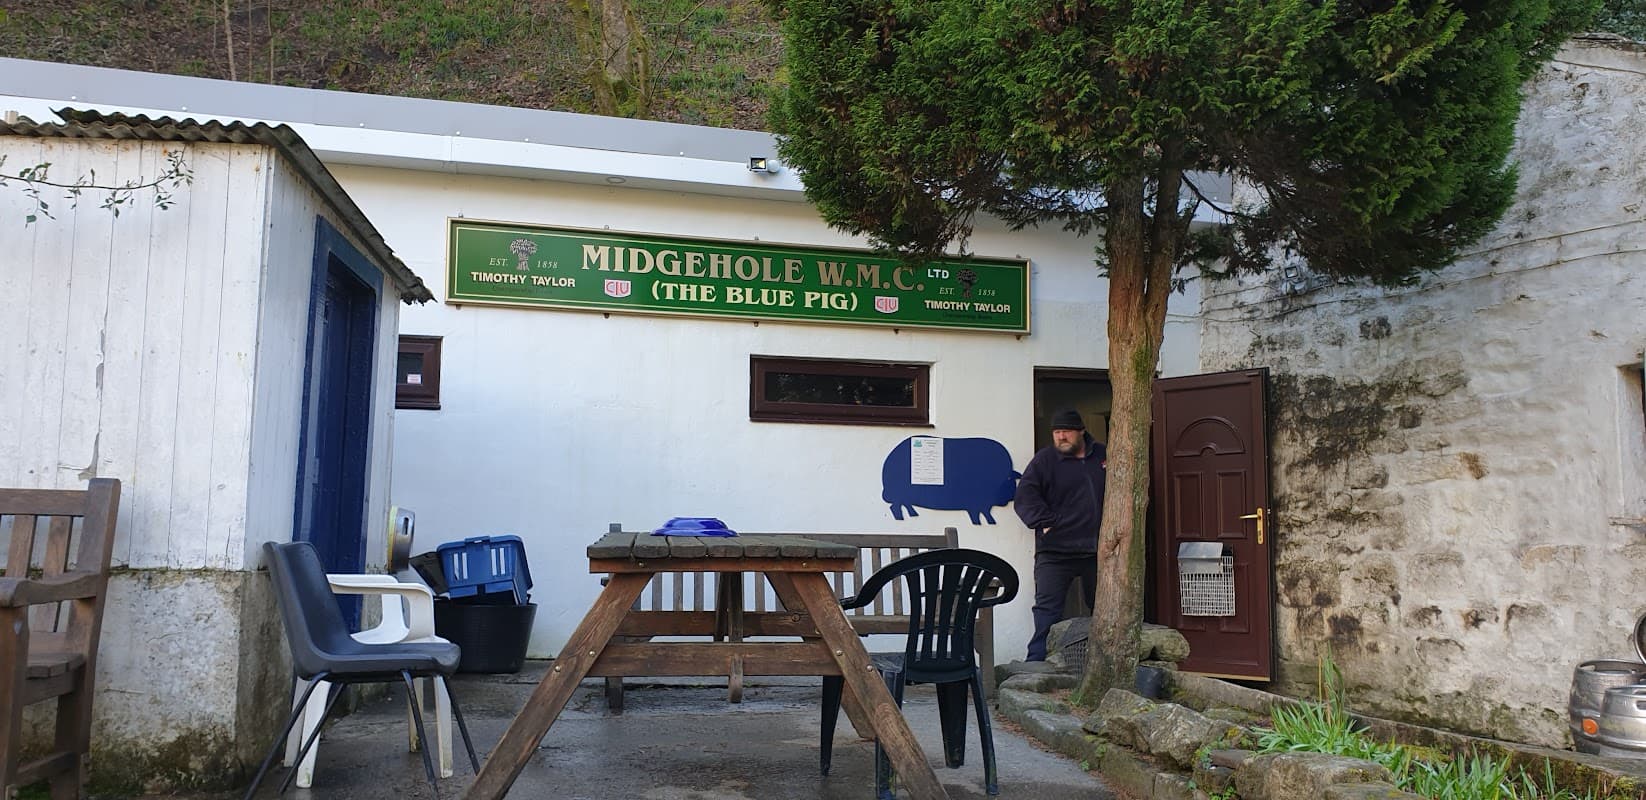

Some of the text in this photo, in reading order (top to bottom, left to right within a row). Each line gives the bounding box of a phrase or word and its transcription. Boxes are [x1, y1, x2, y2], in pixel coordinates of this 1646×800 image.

[489, 257, 558, 269] EST. 1858
[581, 244, 950, 292] MIDGEHOLE W.M.C. LTD
[470, 271, 576, 288] TIMOTHY TAYLOR
[651, 279, 858, 312] (THE BLUE PIG)
[978, 288, 996, 297] 1858
[924, 300, 1011, 313] TIMOTHY TAYLOR
